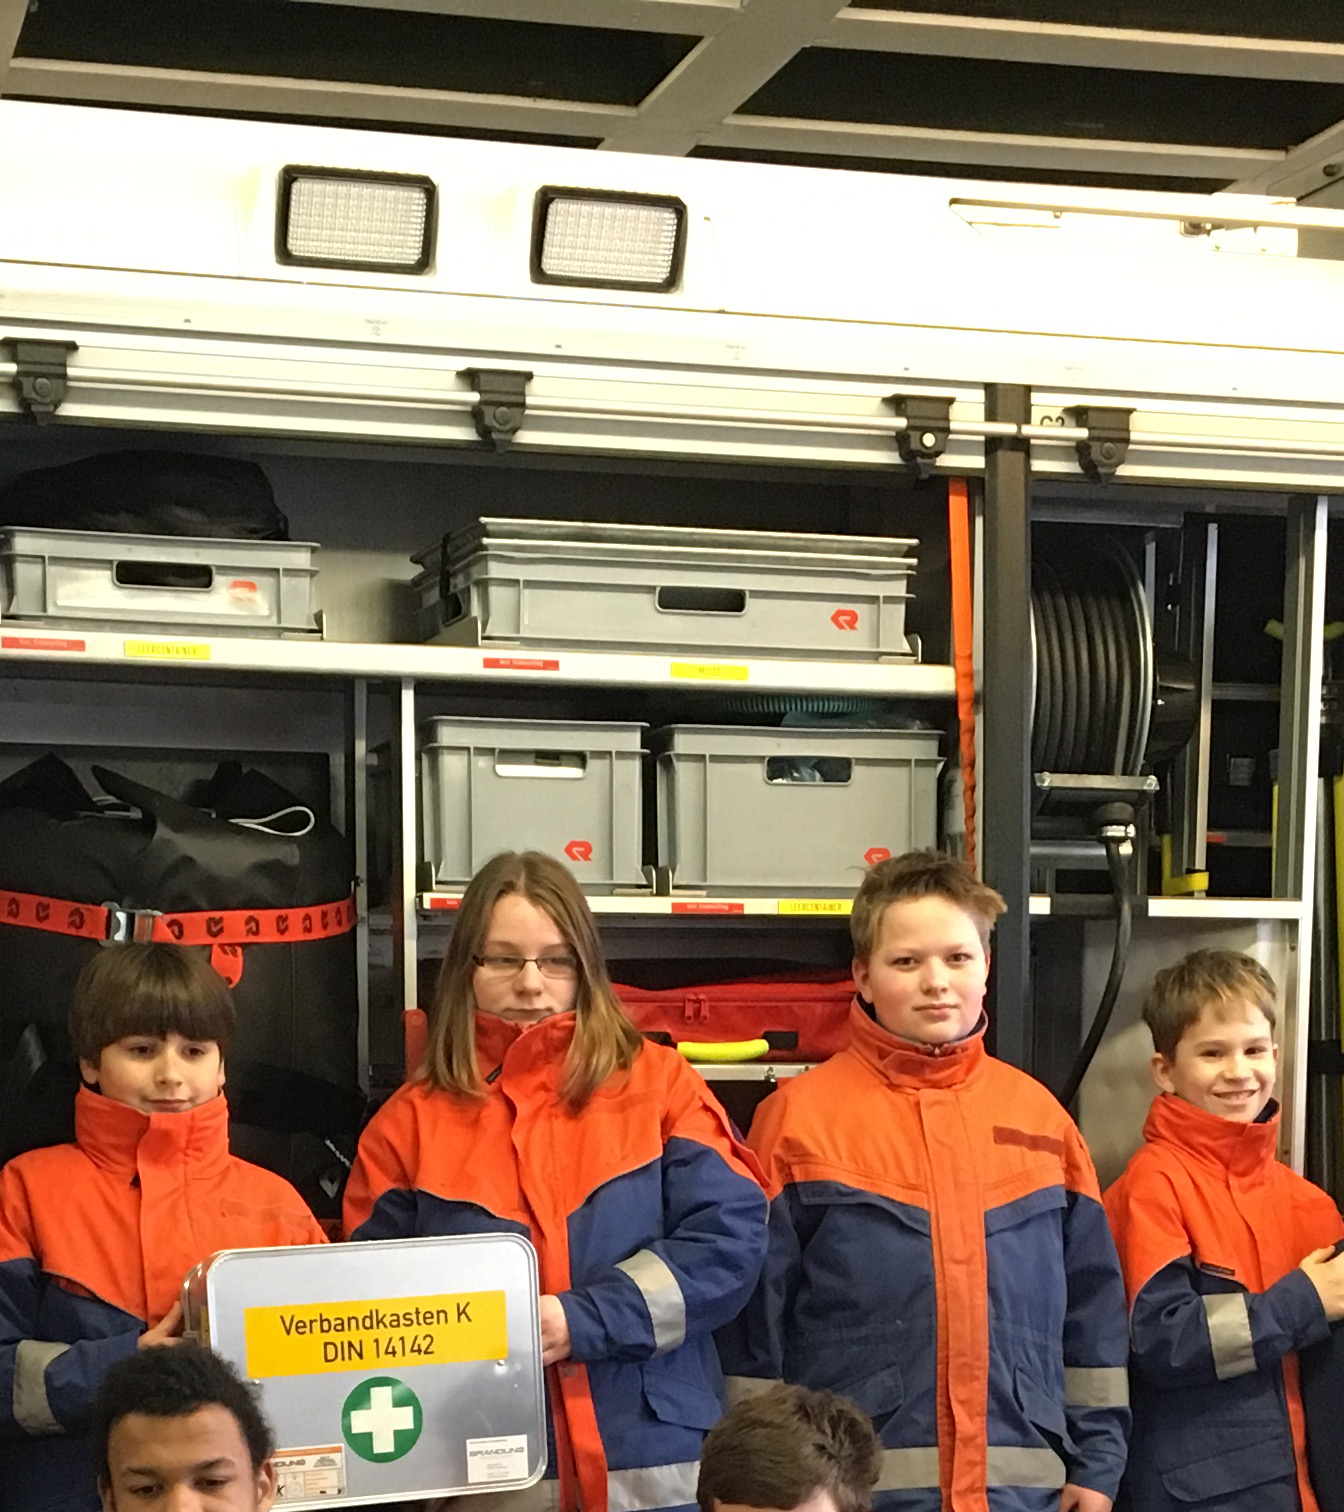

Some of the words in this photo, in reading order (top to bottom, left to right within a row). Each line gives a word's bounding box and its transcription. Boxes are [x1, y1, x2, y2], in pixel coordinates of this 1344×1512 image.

[280, 1306, 449, 1337] Verbandkasten
[456, 1301, 473, 1323] K
[323, 1340, 365, 1364] DIN
[373, 1333, 435, 1359] 14142
